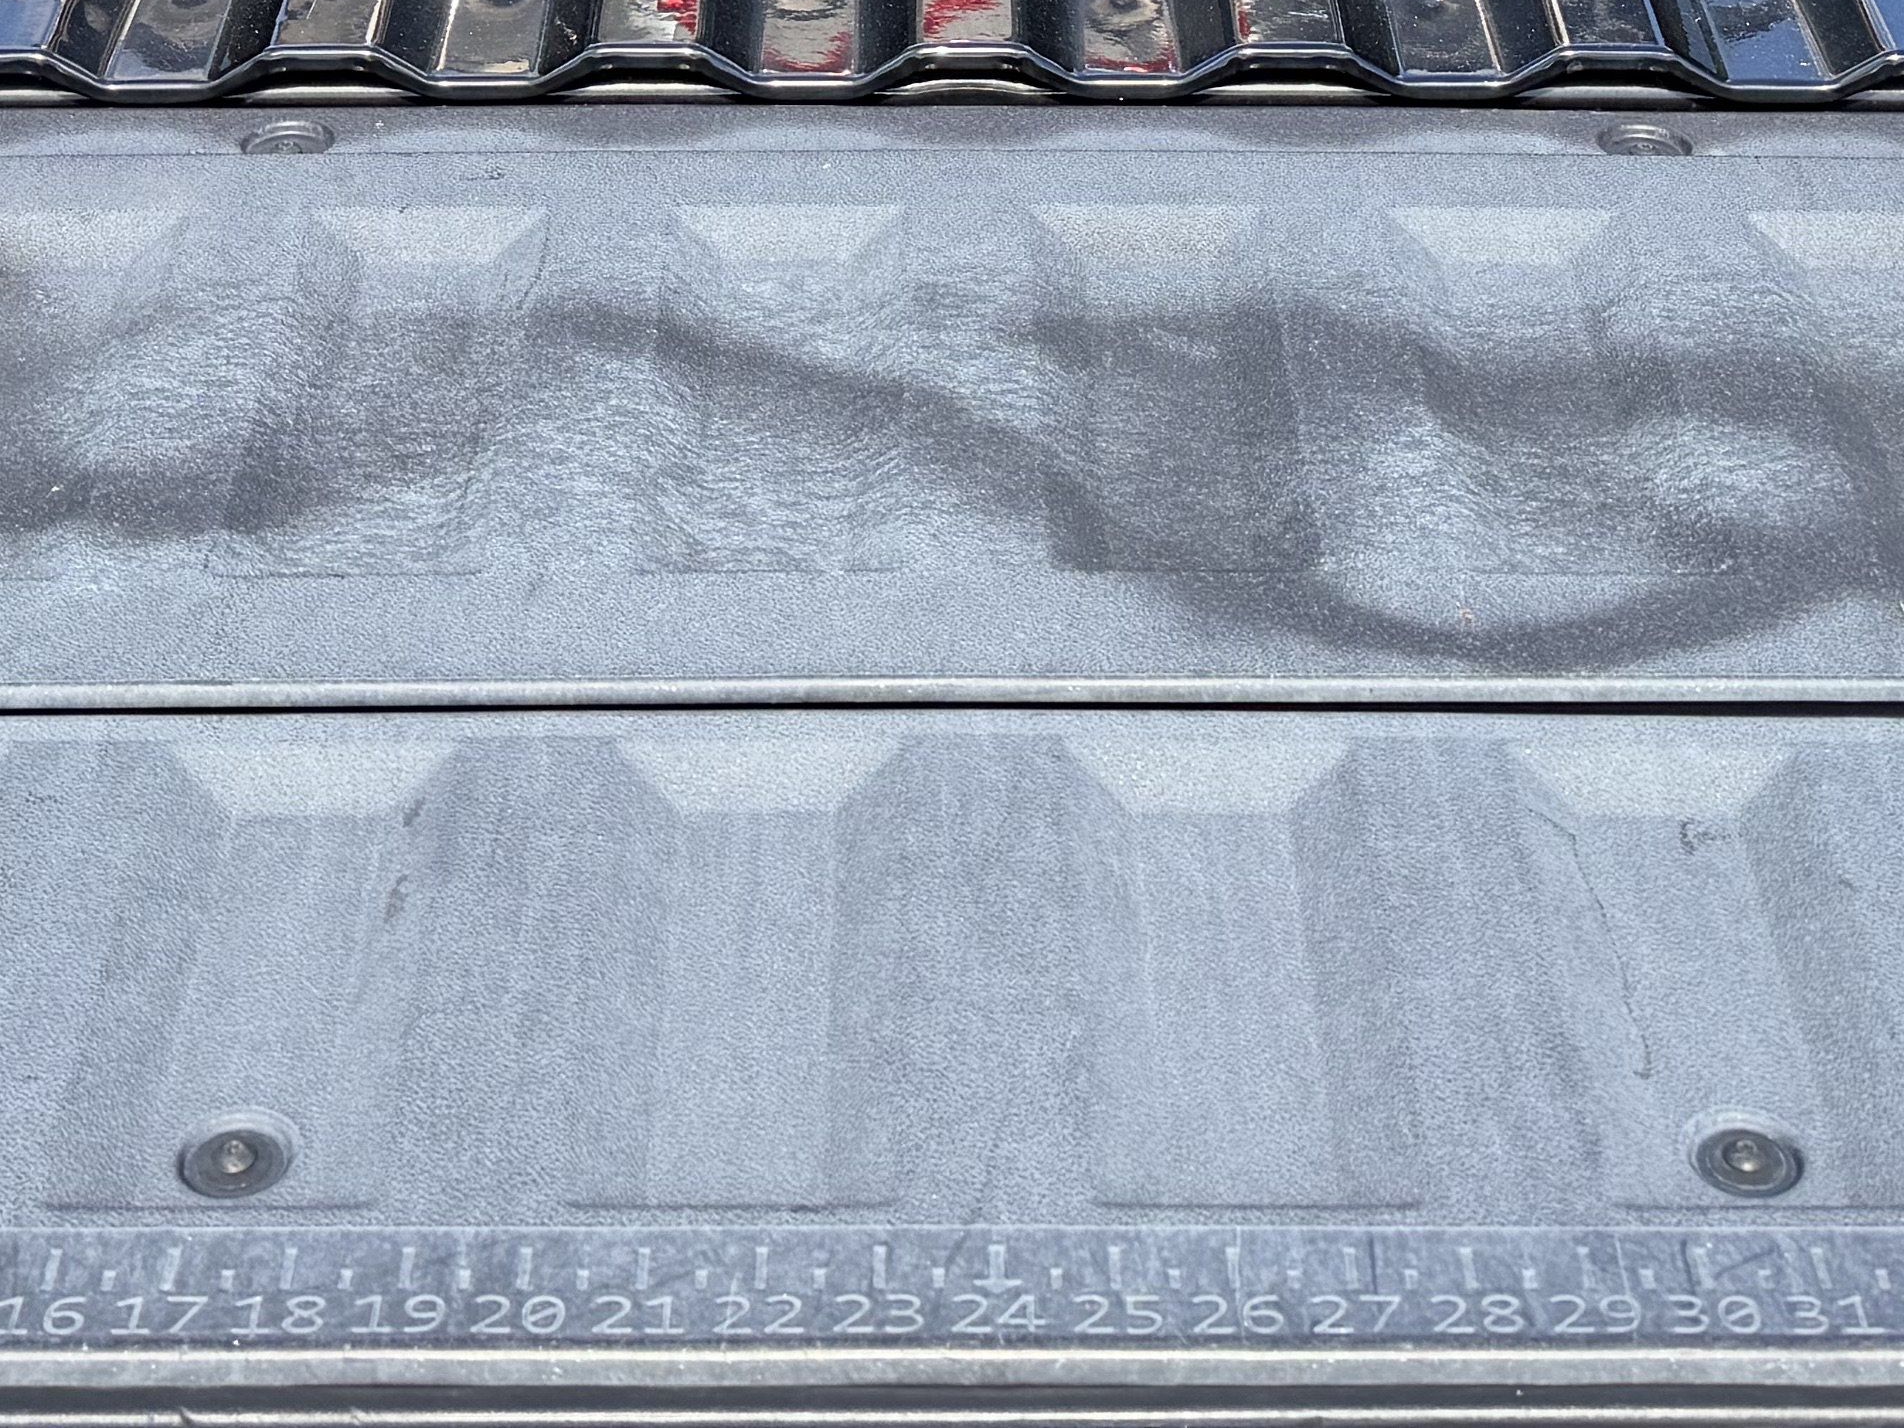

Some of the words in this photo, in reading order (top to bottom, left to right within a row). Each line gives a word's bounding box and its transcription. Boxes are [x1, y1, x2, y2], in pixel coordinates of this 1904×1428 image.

[112, 1295, 210, 1334] 17
[232, 1295, 324, 1334] 18
[349, 1295, 446, 1334] 19
[470, 1295, 566, 1334] 20
[591, 1295, 685, 1334] 21
[713, 1295, 806, 1334] 22
[834, 1295, 925, 1334] 23
[952, 1295, 1047, 1334] 24
[1074, 1295, 1163, 1334] 25
[1192, 1295, 1286, 1334] 26
[1313, 1295, 1402, 1334] 27
[1430, 1295, 1525, 1334] 28
[1550, 1295, 1643, 1334] 29
[1667, 1294, 1762, 1333] 30
[1788, 1294, 1886, 1333] 31
